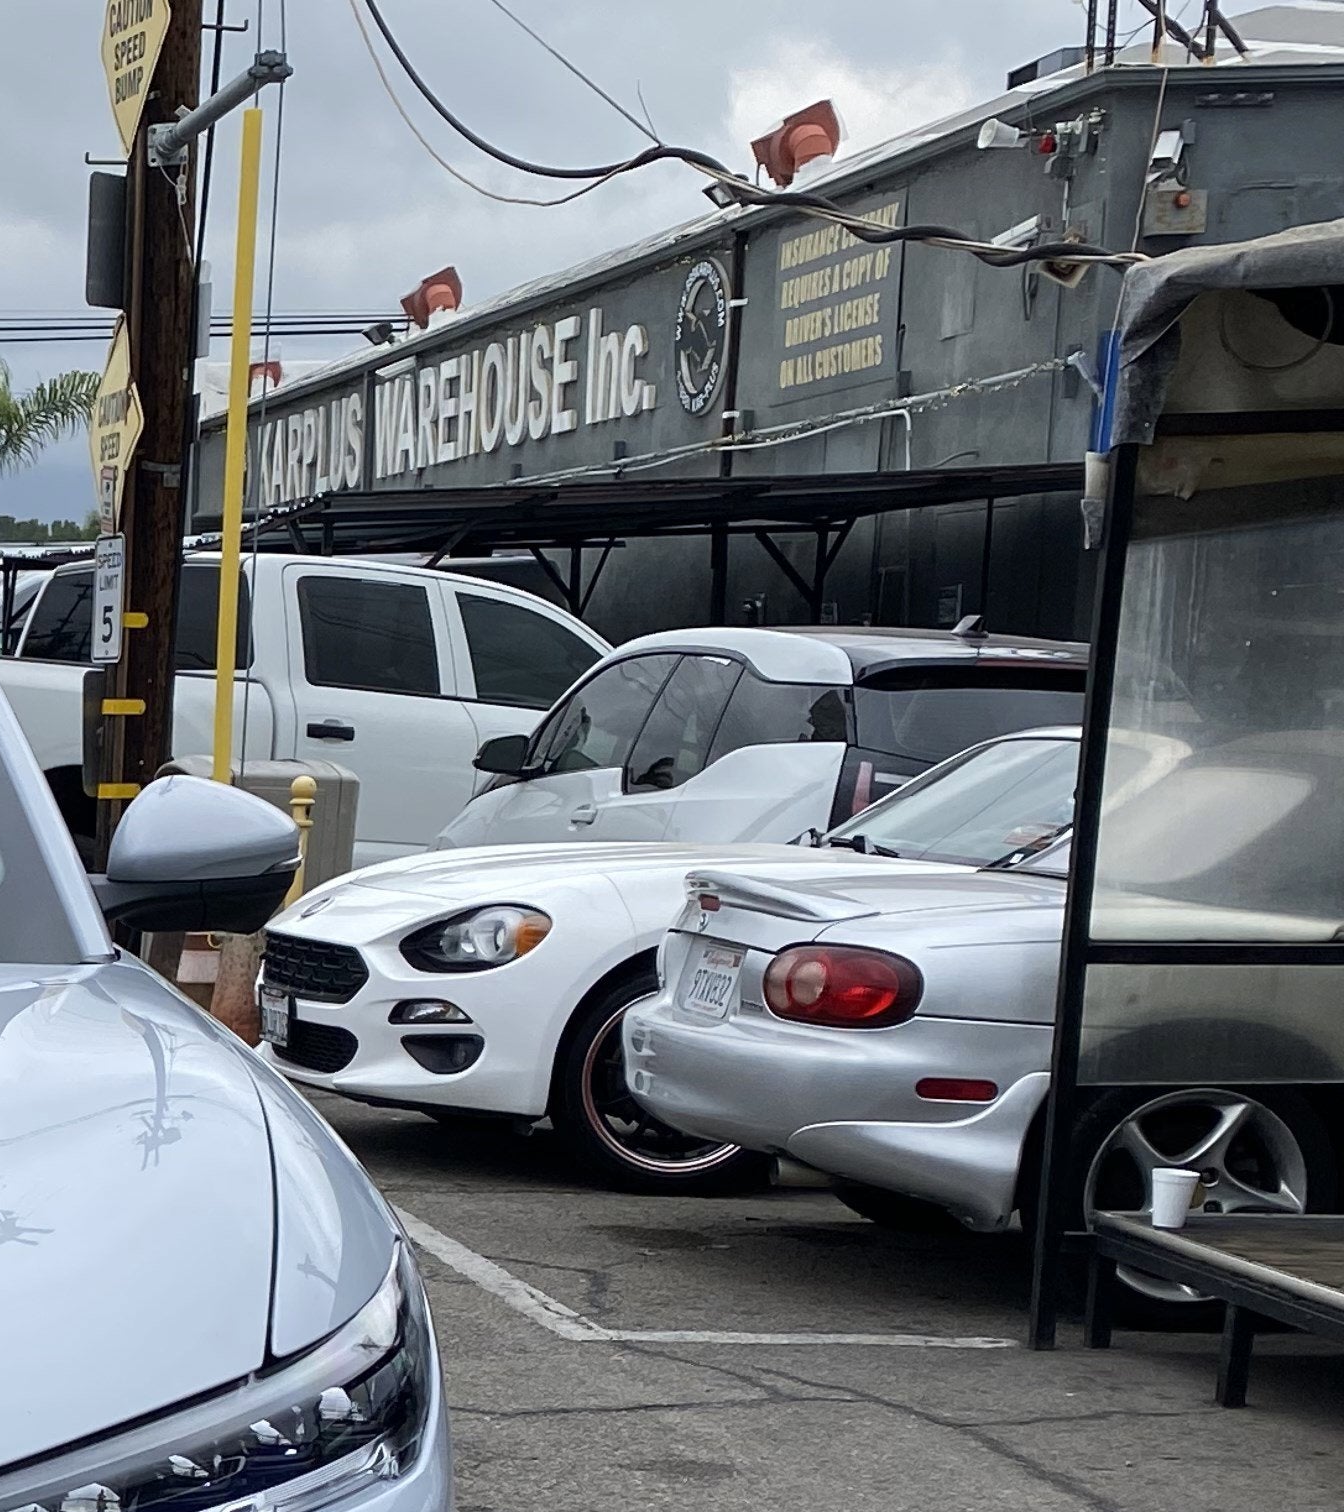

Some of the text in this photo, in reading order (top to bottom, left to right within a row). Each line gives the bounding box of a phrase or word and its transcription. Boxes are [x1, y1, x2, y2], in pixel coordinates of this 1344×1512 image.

[109, 0, 153, 38] CAUTION
[114, 31, 146, 71] SPEED
[115, 66, 143, 105] BUMP
[780, 202, 900, 271] INSURANCE CANY
[780, 246, 891, 310] REQUIRES A COPY OF
[785, 292, 881, 348] DRIVER'S LICENSE
[779, 334, 883, 389] ON ALL CUSTOMERS
[257, 392, 365, 507] KARPLUS
[374, 315, 582, 480] WAREHOUSE
[585, 307, 657, 426] Inc.
[100, 432, 121, 462] SPEED
[98, 552, 122, 569] SPEED
[99, 574, 119, 591] LIMIT
[102, 605, 114, 643] 5
